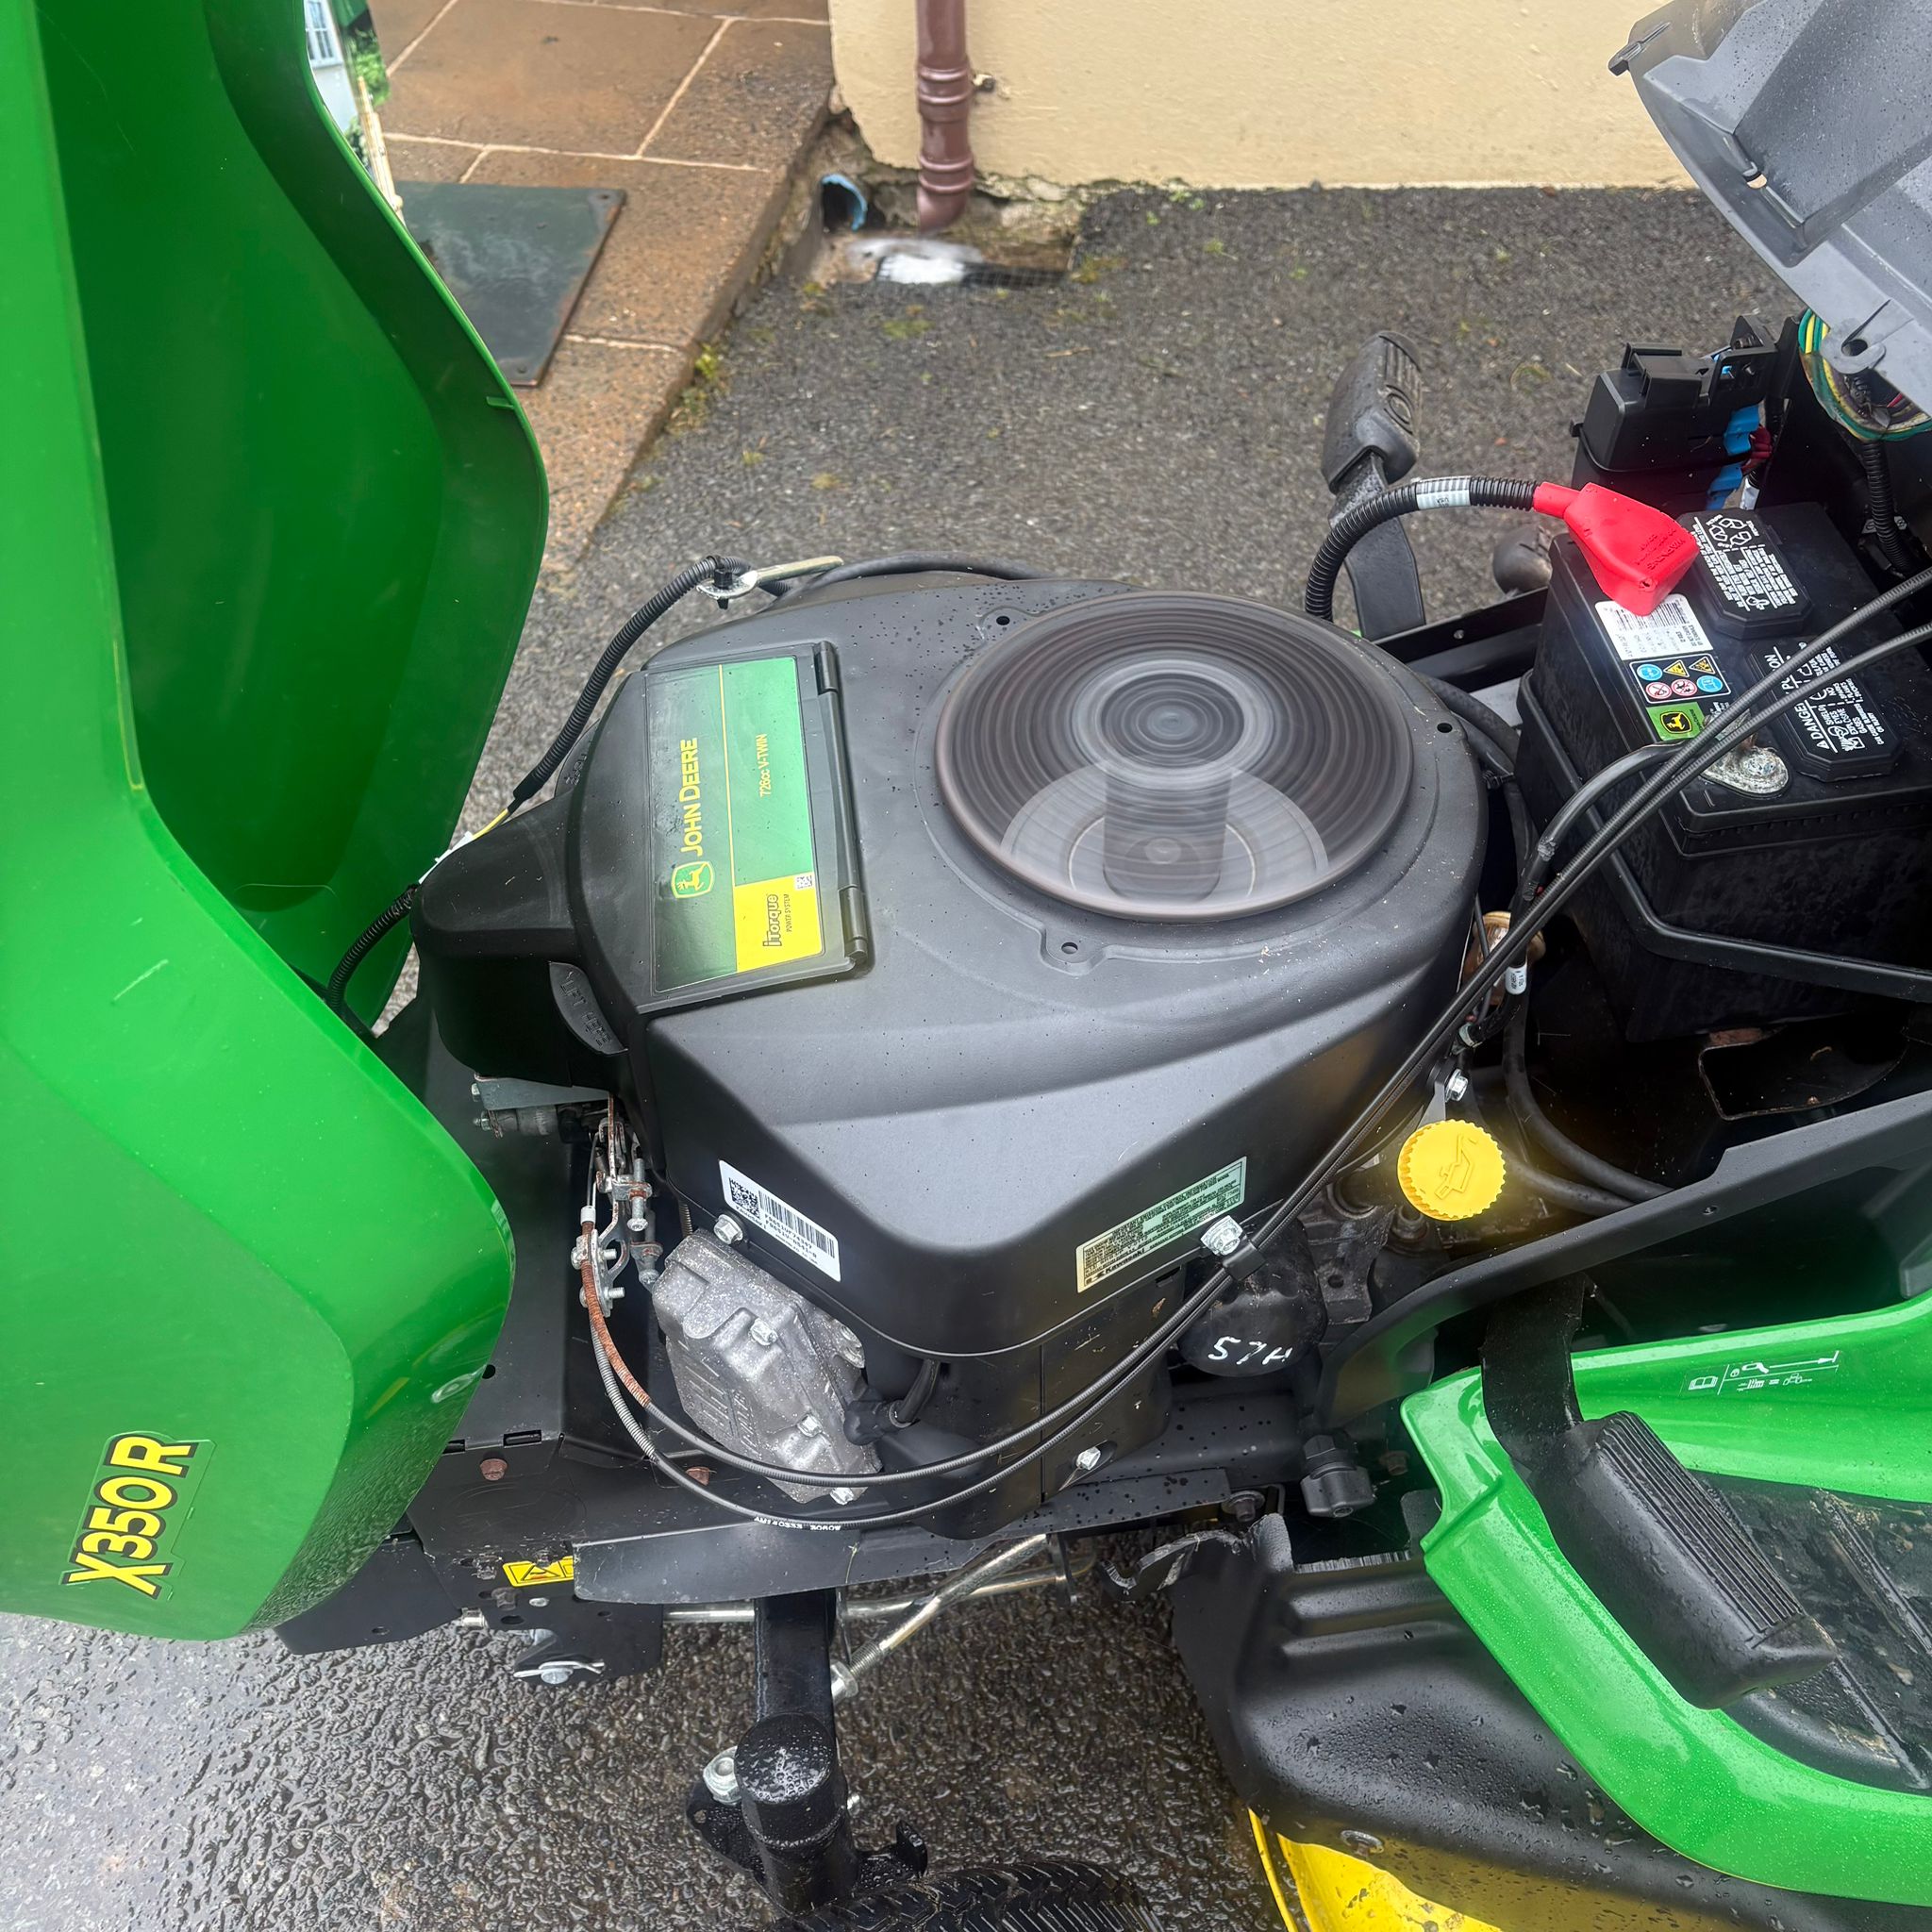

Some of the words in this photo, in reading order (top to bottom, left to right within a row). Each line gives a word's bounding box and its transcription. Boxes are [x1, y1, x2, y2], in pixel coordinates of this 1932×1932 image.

[1825, 687, 1837, 696] NO
[1818, 707, 1834, 725] SHIELD
[1829, 710, 1842, 724] EYES
[756, 734, 767, 767] V-TWIN
[680, 738, 700, 801] DEERE
[758, 770, 772, 797] 726cc
[680, 803, 702, 856] JOHN
[61, 1435, 198, 1600] X350R
